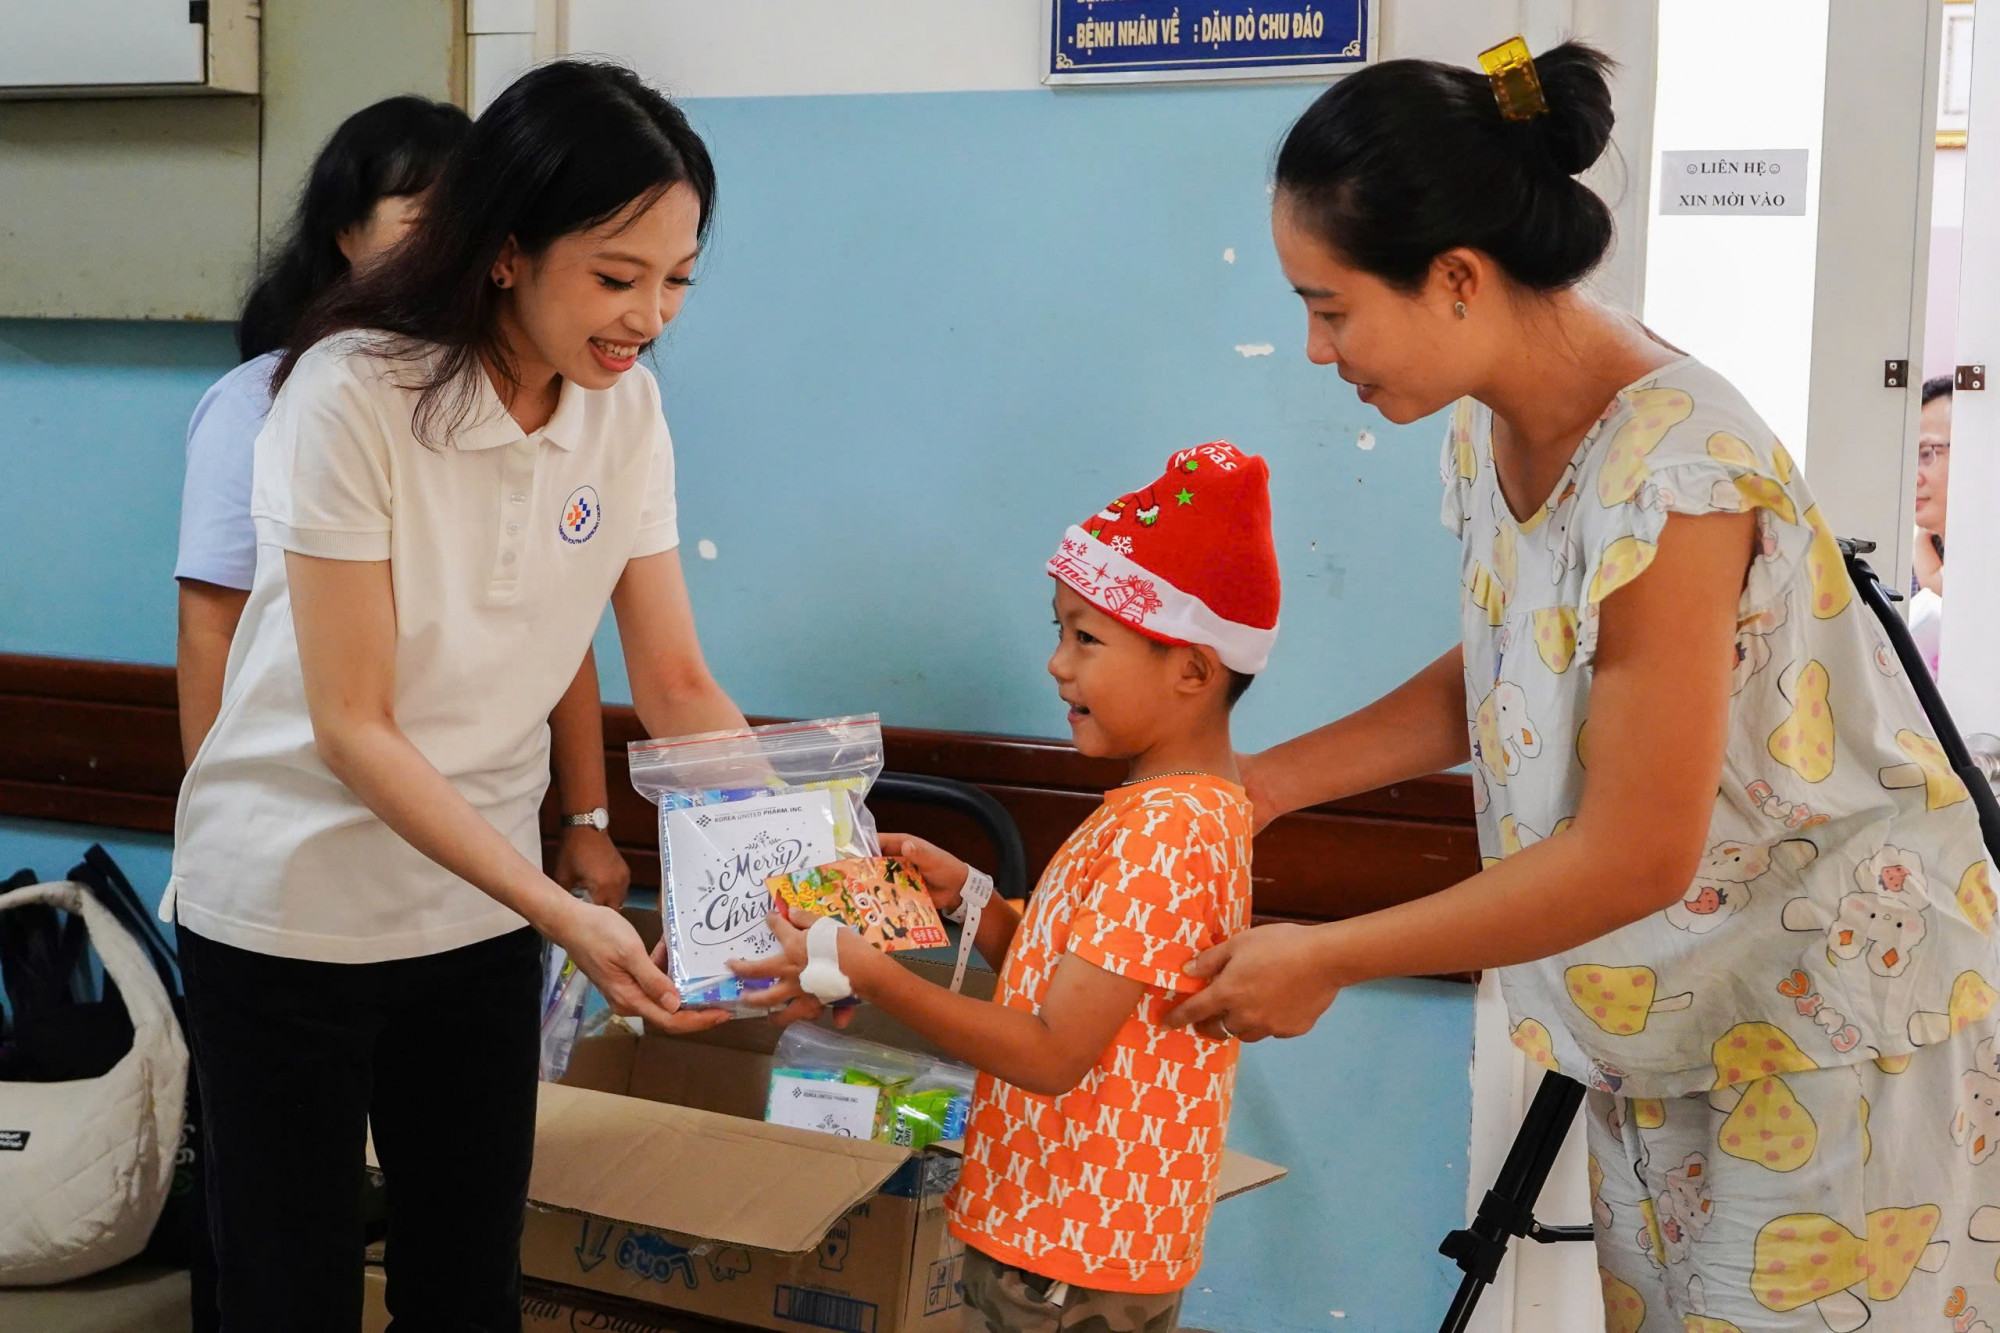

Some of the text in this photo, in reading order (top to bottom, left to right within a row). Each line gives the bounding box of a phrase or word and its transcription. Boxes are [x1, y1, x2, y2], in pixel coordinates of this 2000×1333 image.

[1076, 17, 1115, 55] BỆNH
[1117, 14, 1158, 47] NHÂN
[1161, 7, 1180, 44] VỀ
[1235, 7, 1256, 41] DÒ
[1258, 13, 1289, 40] CHU
[1292, 5, 1324, 39] ĐÁO
[1701, 159, 1767, 177] LIÊN HỆ
[1679, 191, 1785, 207] XIN MỜI VÀO
[719, 838, 801, 892] Merry
